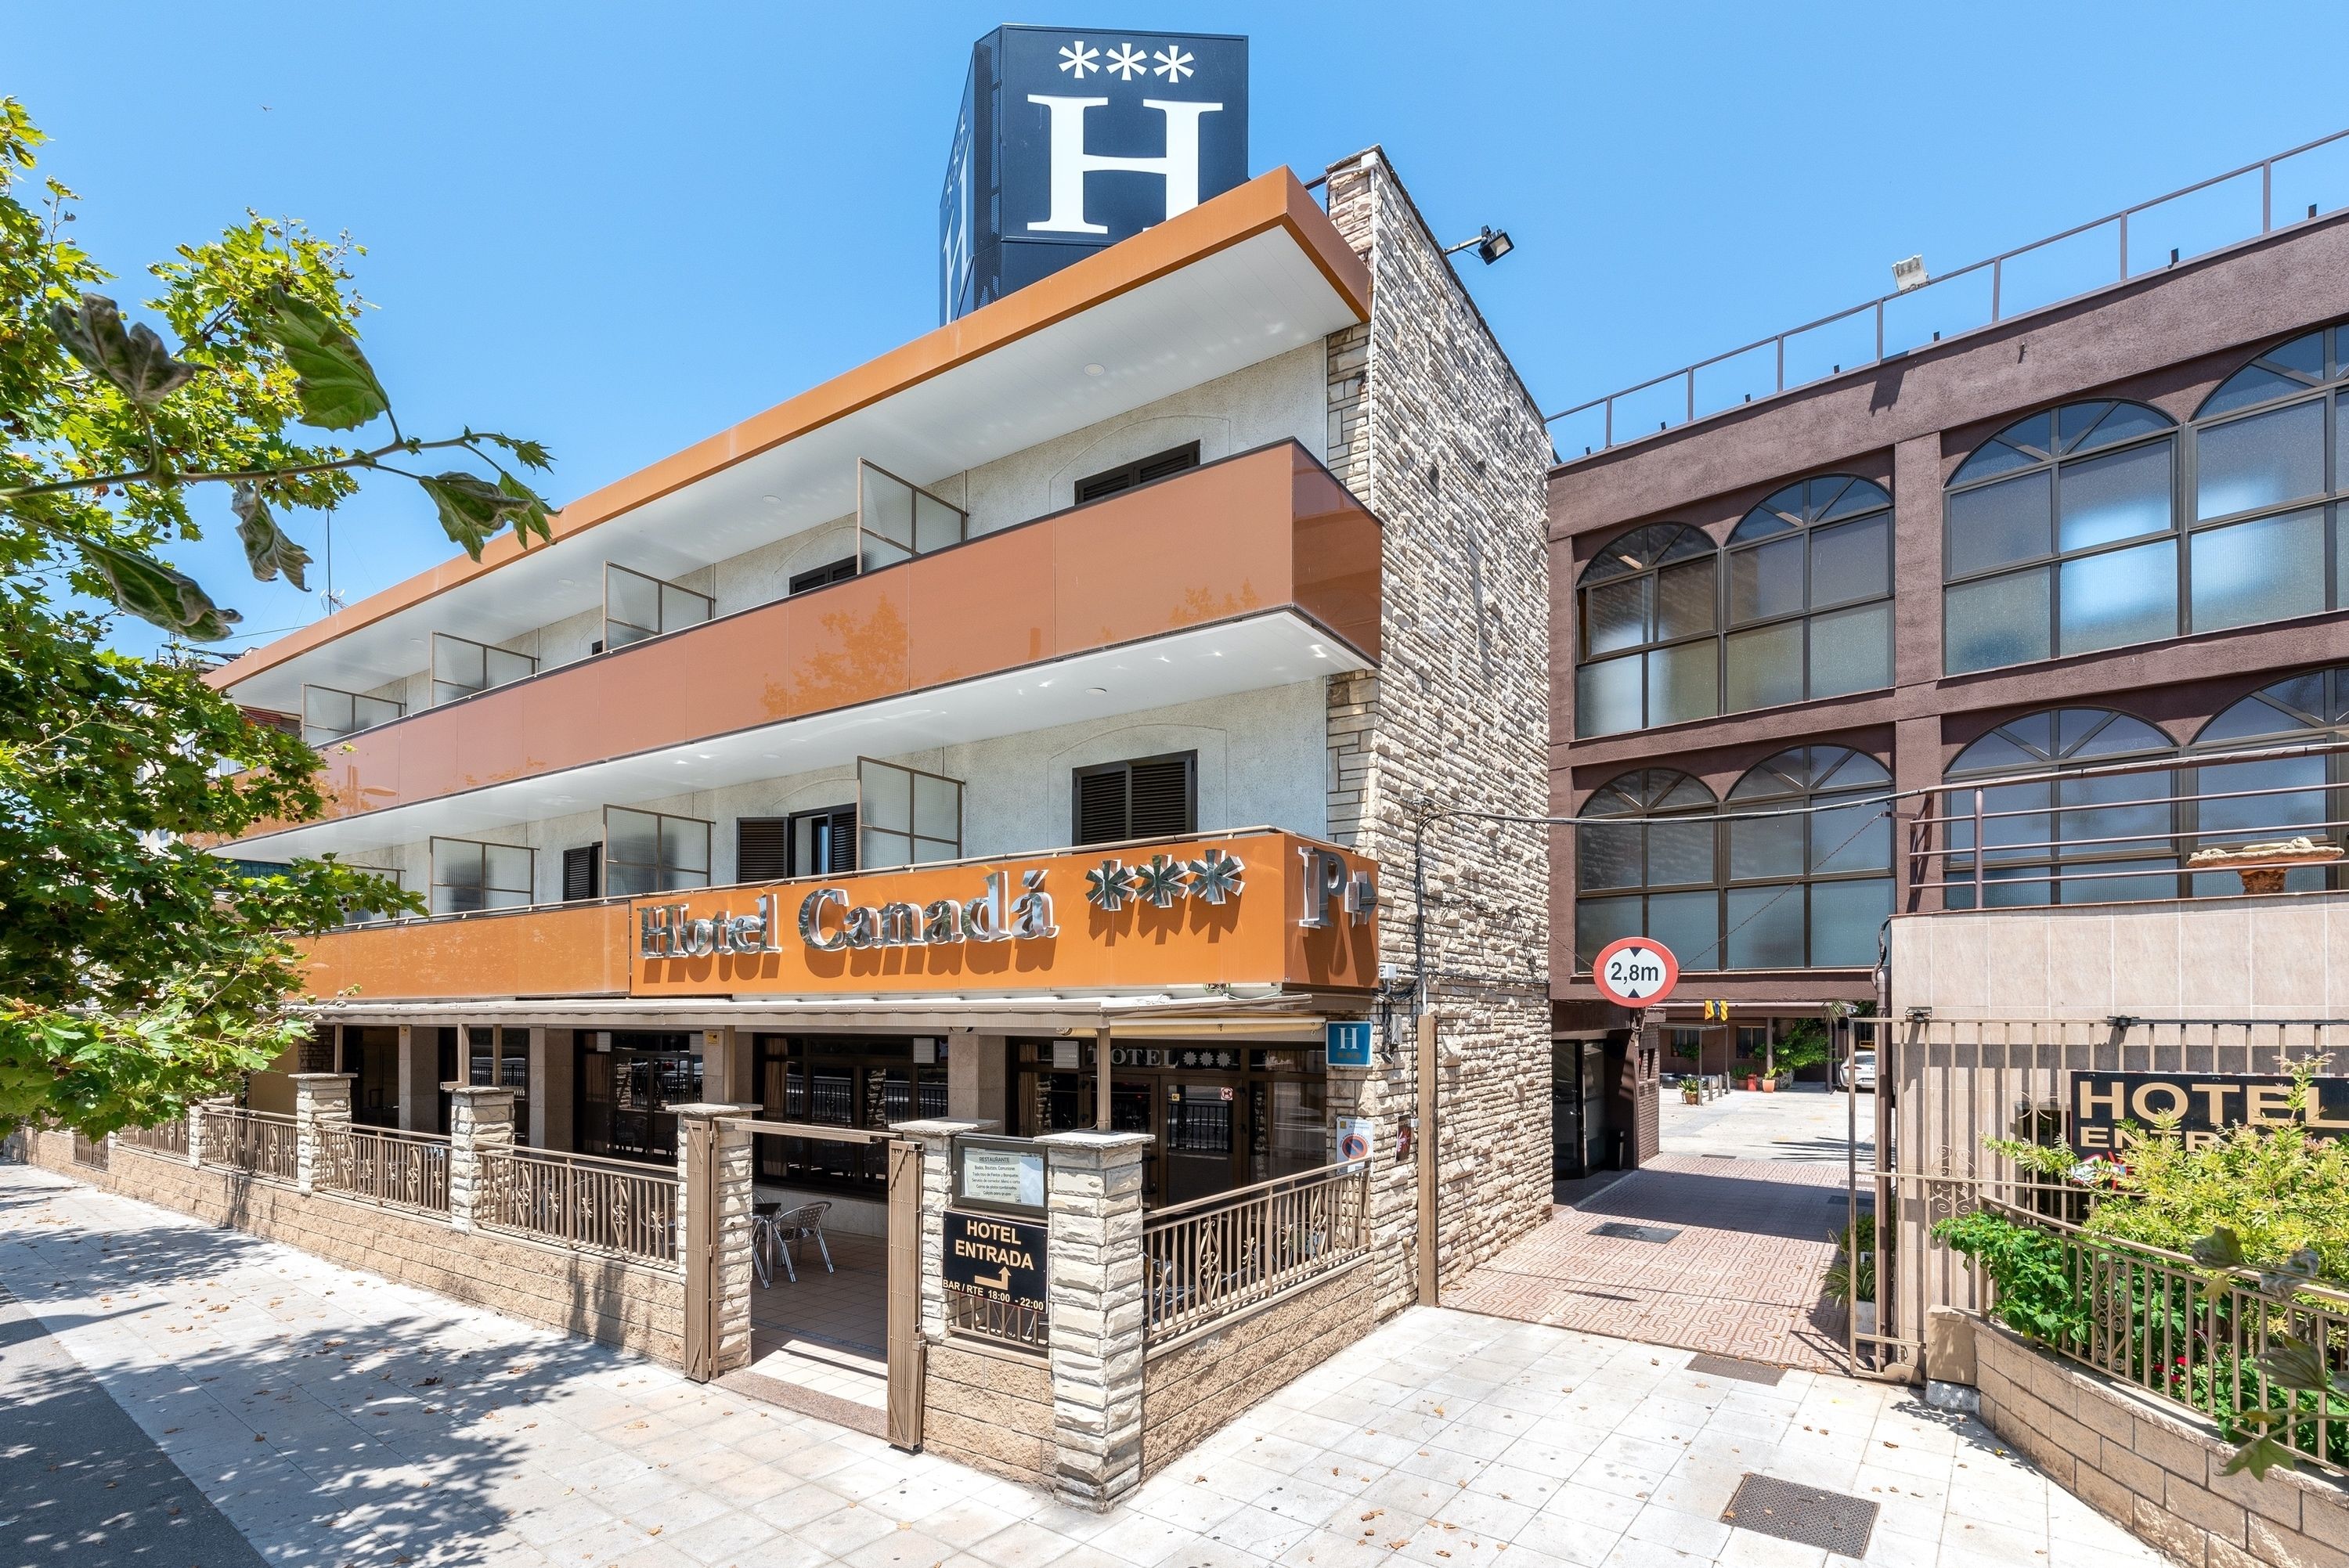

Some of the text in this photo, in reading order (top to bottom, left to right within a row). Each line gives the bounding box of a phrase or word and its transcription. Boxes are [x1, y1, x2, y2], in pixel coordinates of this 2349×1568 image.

[1027, 93, 1224, 234] H
[1298, 845, 1348, 929] P
[637, 869, 1060, 960] Hotel Canadá
[1610, 961, 1659, 985] 2,8m
[1338, 1027, 1359, 1050] H
[2079, 1080, 2349, 1129] HOTEL
[966, 1220, 1022, 1245] HOTEL
[955, 1239, 1034, 1271] ENTRADA
[943, 1278, 961, 1292] BAR
[966, 1285, 984, 1296] RTE
[987, 1290, 1011, 1303] 18:00
[1019, 1297, 1045, 1310] 22:00
